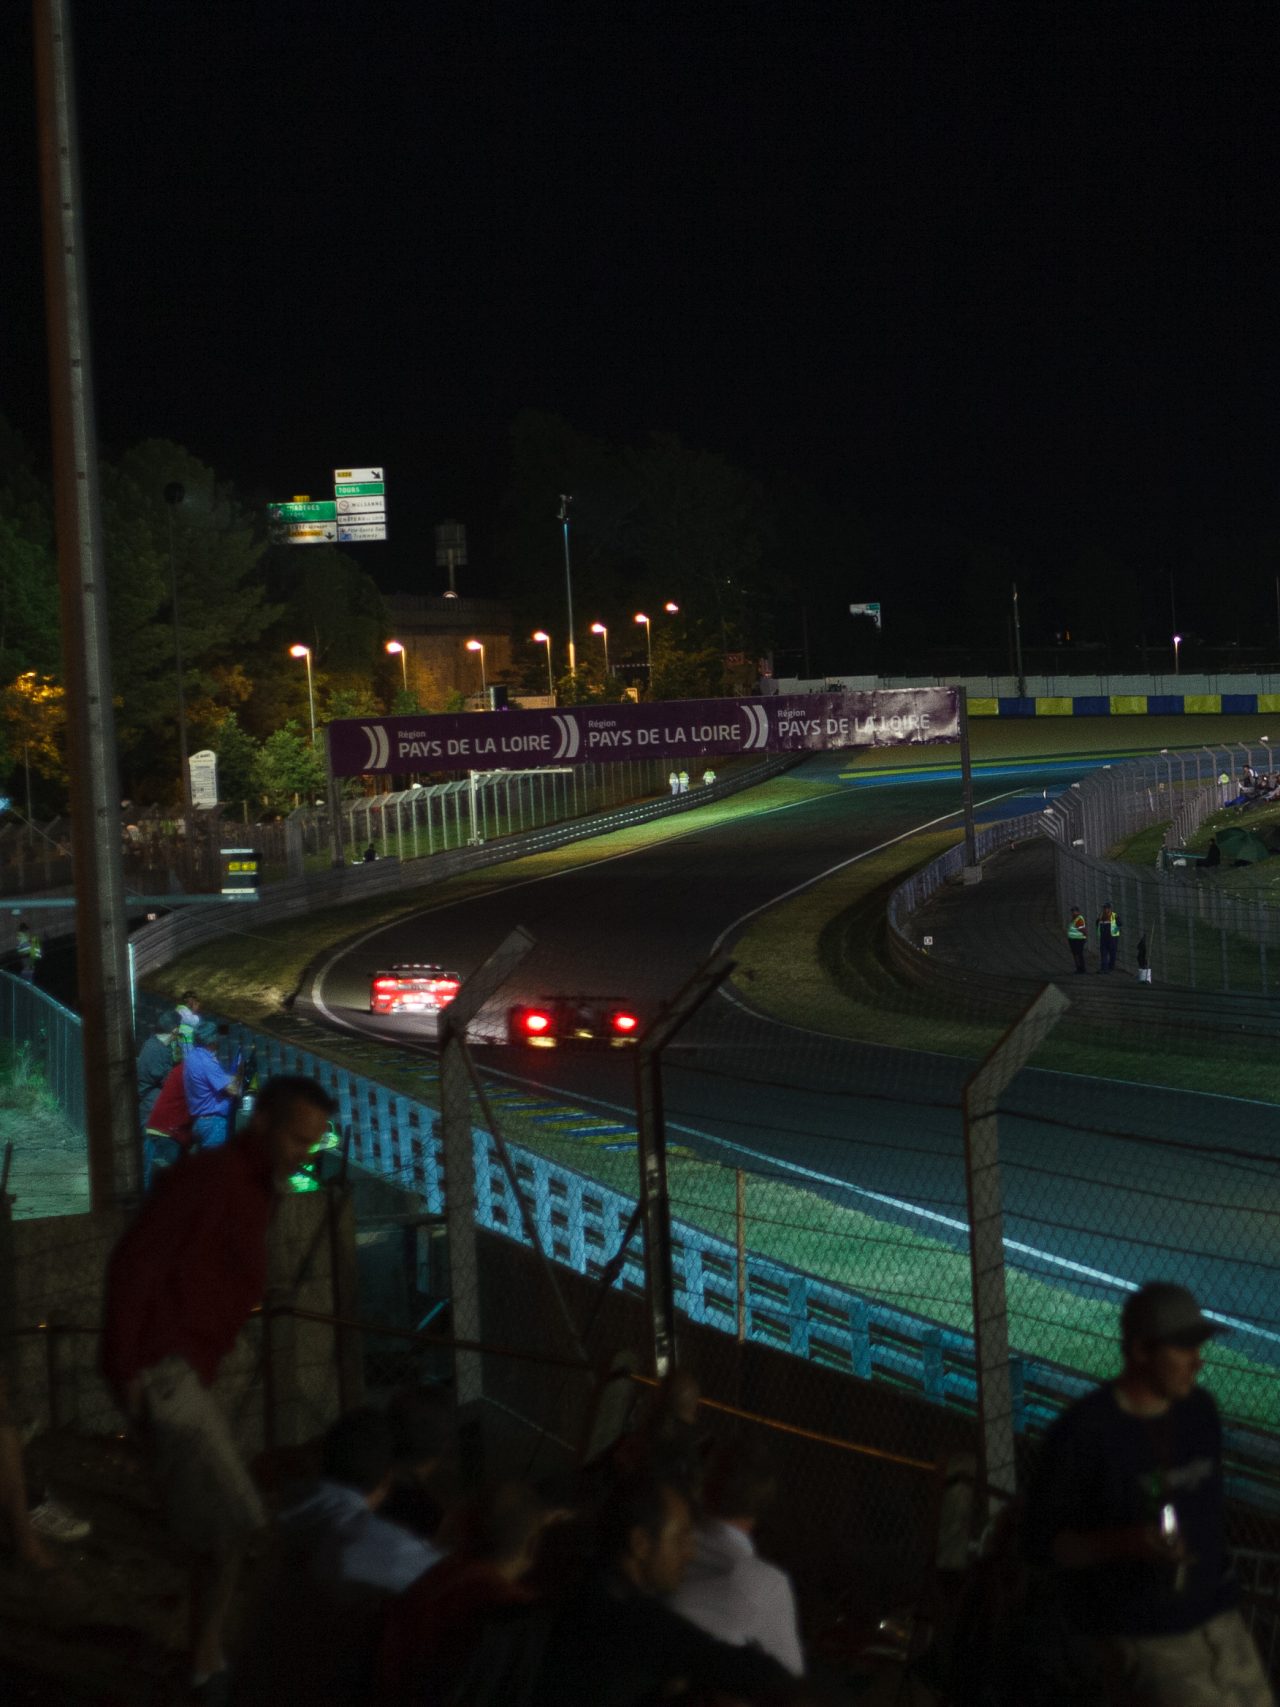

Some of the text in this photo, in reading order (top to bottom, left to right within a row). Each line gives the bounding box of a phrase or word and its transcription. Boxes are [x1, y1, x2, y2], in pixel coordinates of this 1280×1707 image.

[778, 708, 806, 718] Région
[588, 719, 616, 729] Région
[779, 713, 930, 736] PAYS DE LA LOIRE
[398, 730, 426, 740] Région
[589, 725, 740, 747] PAYS DE LA LOIRE
[399, 735, 550, 758] PAYS DE LA LOIRE
